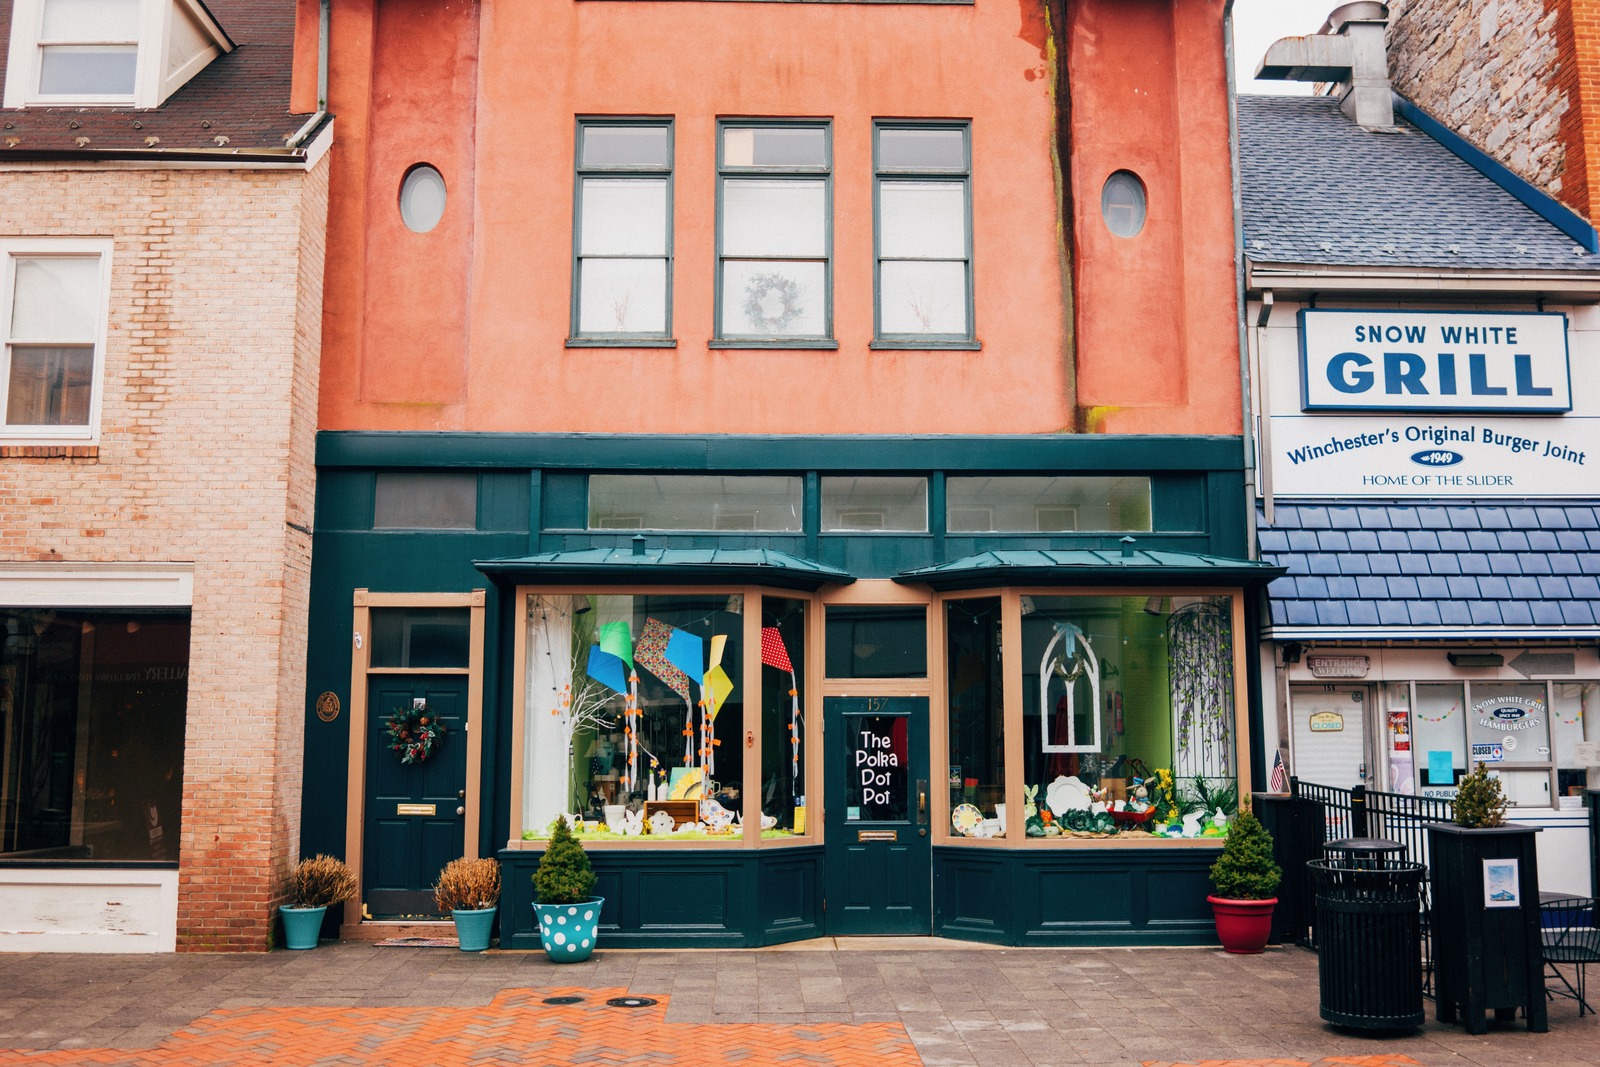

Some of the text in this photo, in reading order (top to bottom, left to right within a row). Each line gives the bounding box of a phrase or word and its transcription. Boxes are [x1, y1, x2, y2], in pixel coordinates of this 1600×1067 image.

[1355, 325, 1518, 345] SNOW WHITE
[1326, 352, 1553, 397] GRILL
[1286, 426, 1586, 466] Winchester's Original Burger Joint
[1429, 452, 1453, 464] 1949
[1363, 475, 1514, 486] HOME OF THE SLIDER
[1315, 658, 1366, 668] ENTRANCE
[1318, 667, 1365, 675] WELCOME
[868, 697, 889, 711] 157
[1472, 696, 1546, 713] SNOW WHITE GRILL
[1479, 717, 1540, 731] HAMBURGERS
[860, 731, 891, 749] The
[1472, 746, 1492, 755] CLOSED
[855, 750, 898, 767] Polka
[861, 768, 892, 786] Dot
[863, 788, 891, 805] Pot
[1424, 790, 1459, 798] NO PUBLIC
